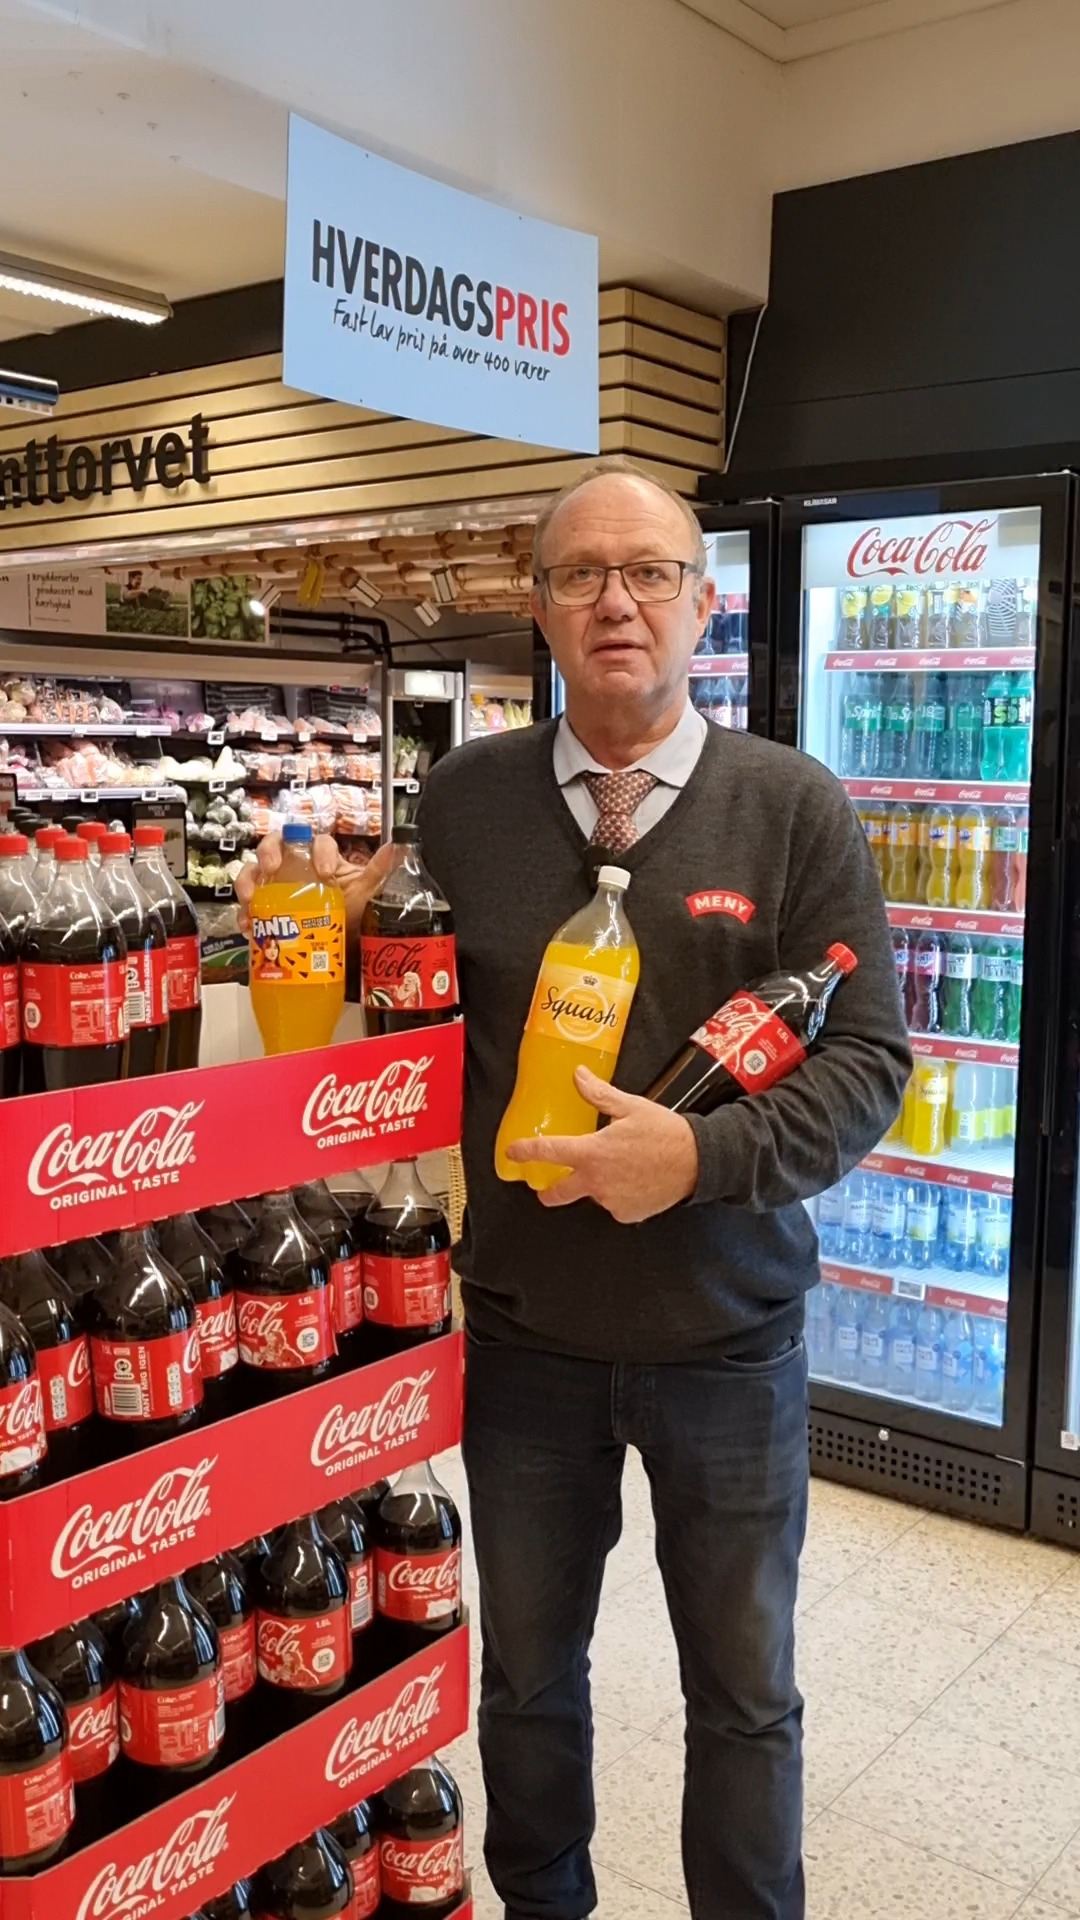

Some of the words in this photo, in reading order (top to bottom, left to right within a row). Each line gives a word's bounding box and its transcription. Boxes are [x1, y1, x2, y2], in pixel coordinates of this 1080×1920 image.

[311, 218, 571, 357] HVERDAGSPRIS
[333, 297, 369, 333] Fast
[370, 310, 395, 343] lav
[396, 326, 426, 352] pris
[428, 333, 450, 360] på
[452, 345, 481, 365] over
[483, 349, 510, 372] 400
[847, 519, 998, 578] Coca-Cola
[252, 915, 300, 938] FANTA
[694, 894, 750, 914] MENY
[541, 986, 619, 1028] Squash
[302, 1055, 435, 1136] Coca-Cola
[27, 1099, 206, 1196] Coca-Cola
[316, 1126, 376, 1149] ORIGINAL
[379, 1116, 416, 1135] TASTE
[49, 1181, 128, 1210] ORIGINAL
[132, 1170, 180, 1192] TASTE
[138, 1346, 147, 1370] IGEN
[140, 1372, 149, 1391] MIG
[142, 1393, 151, 1418] PANT
[310, 1367, 437, 1467] Coca-Cola
[325, 1447, 381, 1477] ORIGINAL
[383, 1428, 418, 1450] TASTE
[51, 1454, 219, 1579] Coca-Cola
[71, 1550, 147, 1589] ORIGINAL
[150, 1525, 196, 1554] TASTE
[325, 1660, 447, 1782] Coca-Cola
[338, 1750, 393, 1788] ORIGINAL
[396, 1725, 429, 1752] TASTE
[76, 1791, 238, 1920] Coca-Cola
[169, 1861, 215, 1896] TASTE
